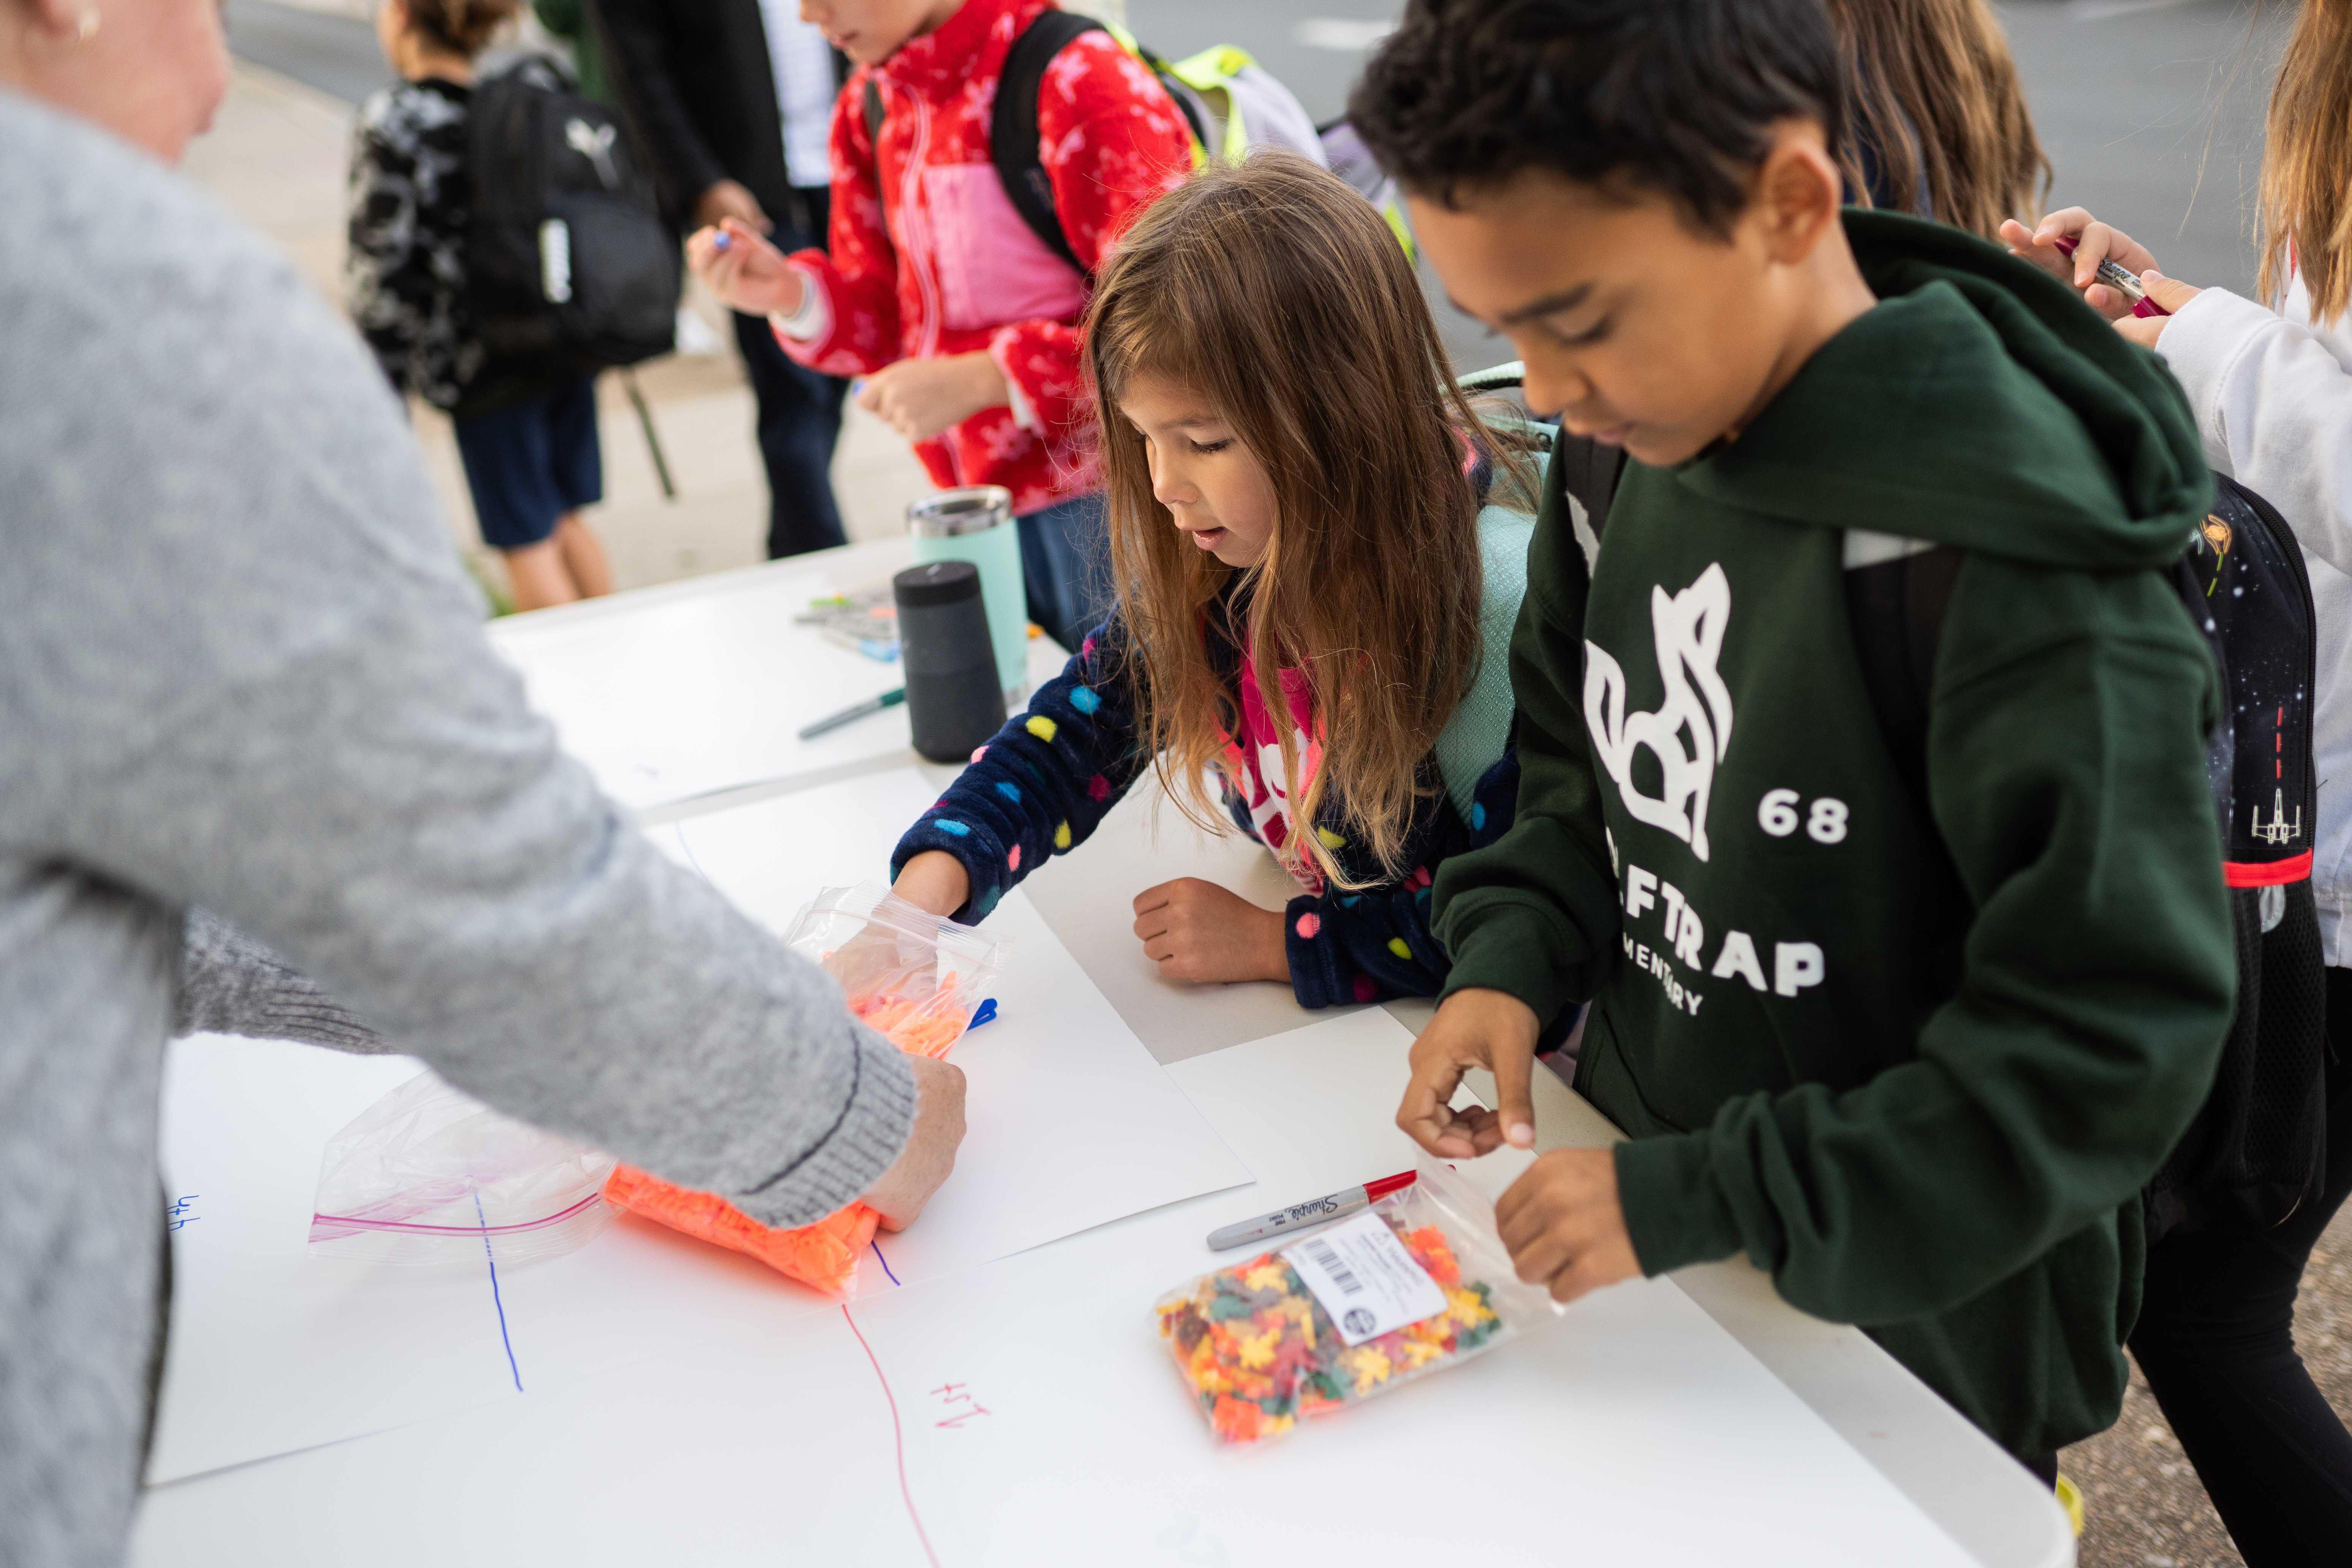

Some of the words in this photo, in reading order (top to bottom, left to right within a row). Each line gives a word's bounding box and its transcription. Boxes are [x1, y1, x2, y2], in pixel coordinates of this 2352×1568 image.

[1757, 787, 1849, 844] 68
[1606, 826, 1824, 997] FTRAP
[1288, 1194, 1338, 1221] Sharpie
